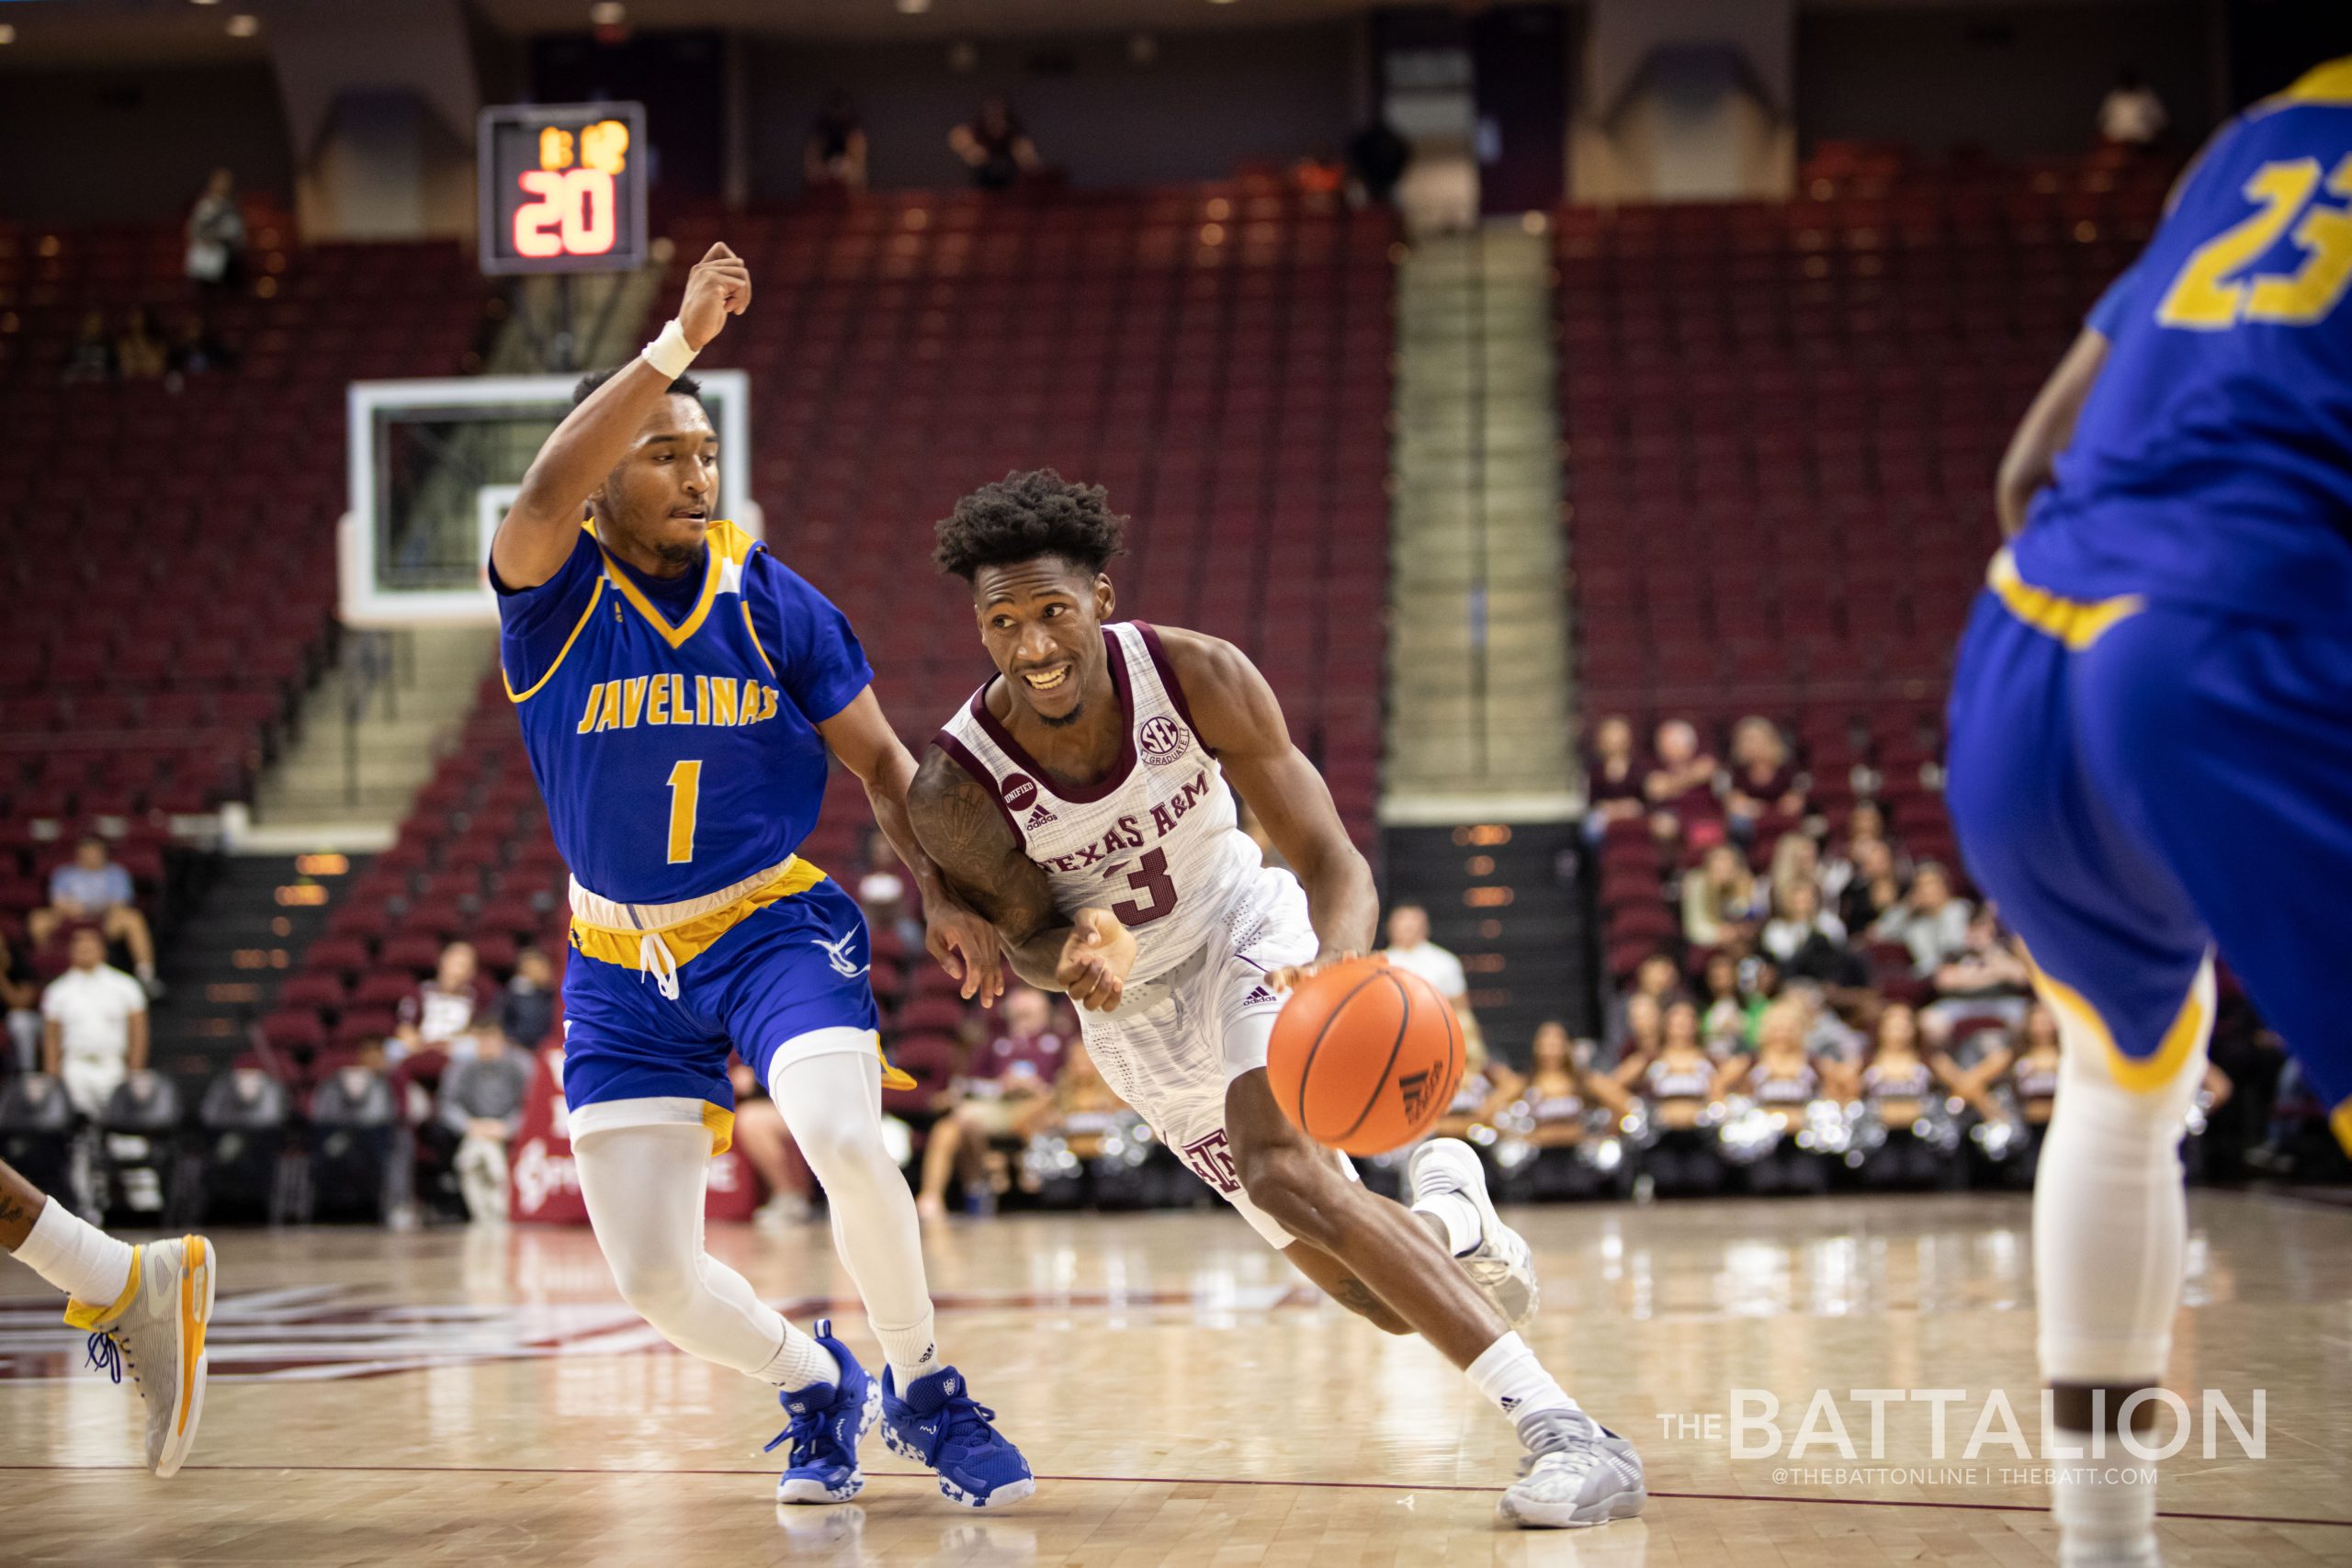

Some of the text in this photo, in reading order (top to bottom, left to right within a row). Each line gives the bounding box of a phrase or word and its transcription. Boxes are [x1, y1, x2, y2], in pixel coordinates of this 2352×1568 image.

[514, 167, 616, 258] 20
[577, 673, 779, 734] JAVELINAS
[1142, 717, 1177, 752] SEC
[1149, 739, 1187, 764] GRADUATE
[666, 760, 703, 864] 1
[1004, 782, 1034, 804] UNIFIED
[1026, 814, 1058, 831] adidas
[1036, 770, 1210, 874] TEXAS A&M
[1102, 846, 1178, 927] 3
[1243, 996, 1277, 1007] adidas
